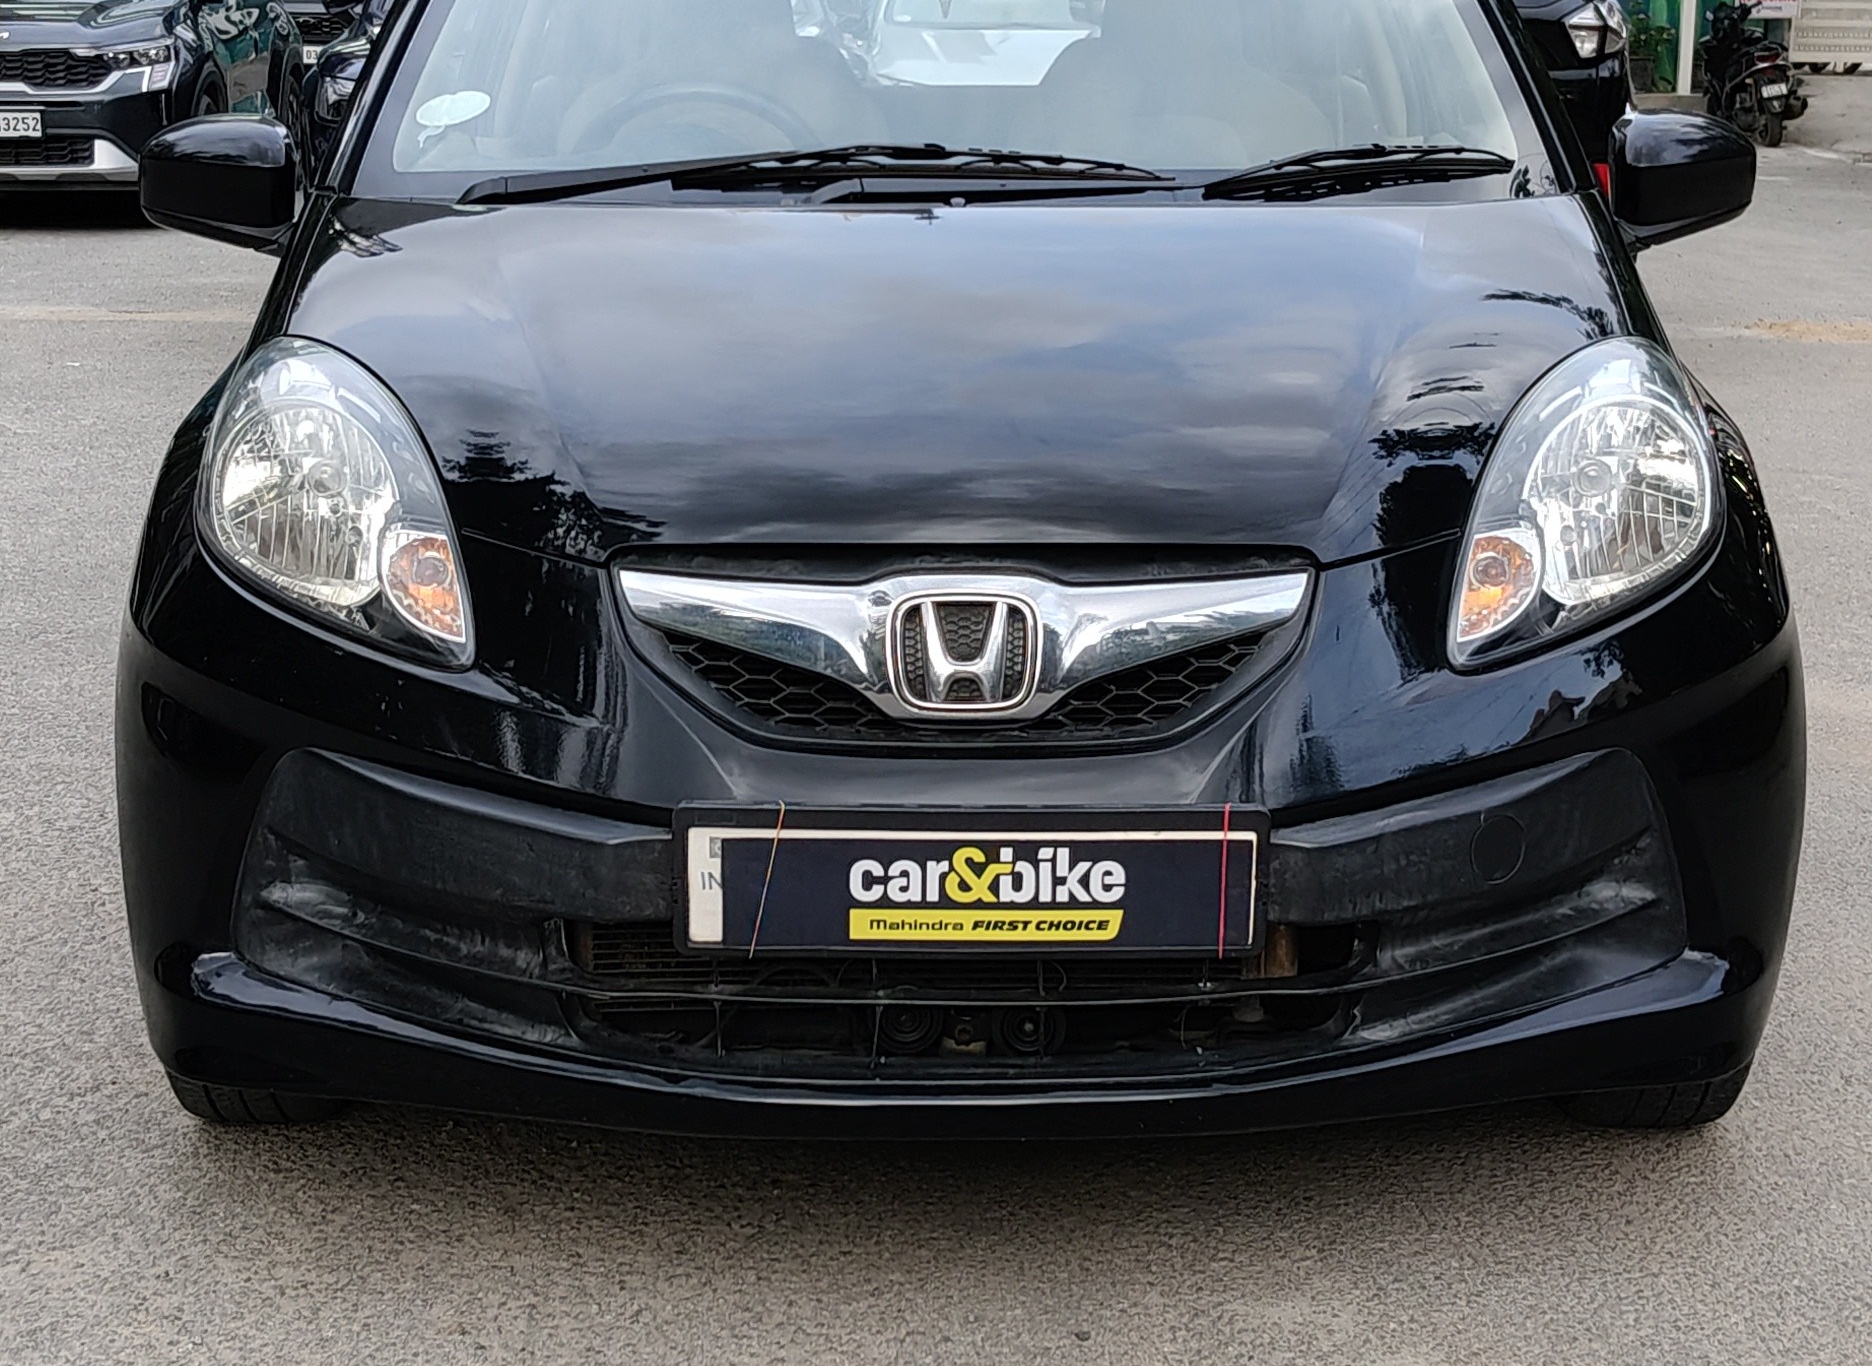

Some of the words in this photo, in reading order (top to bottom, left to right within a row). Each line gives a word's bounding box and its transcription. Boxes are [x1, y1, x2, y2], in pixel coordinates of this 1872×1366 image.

[0, 116, 40, 132] 3252
[849, 847, 1126, 903] car&bike
[869, 919, 964, 931] Mahindra
[971, 920, 1032, 931] FIRST
[1035, 920, 1110, 931] CHOICE
